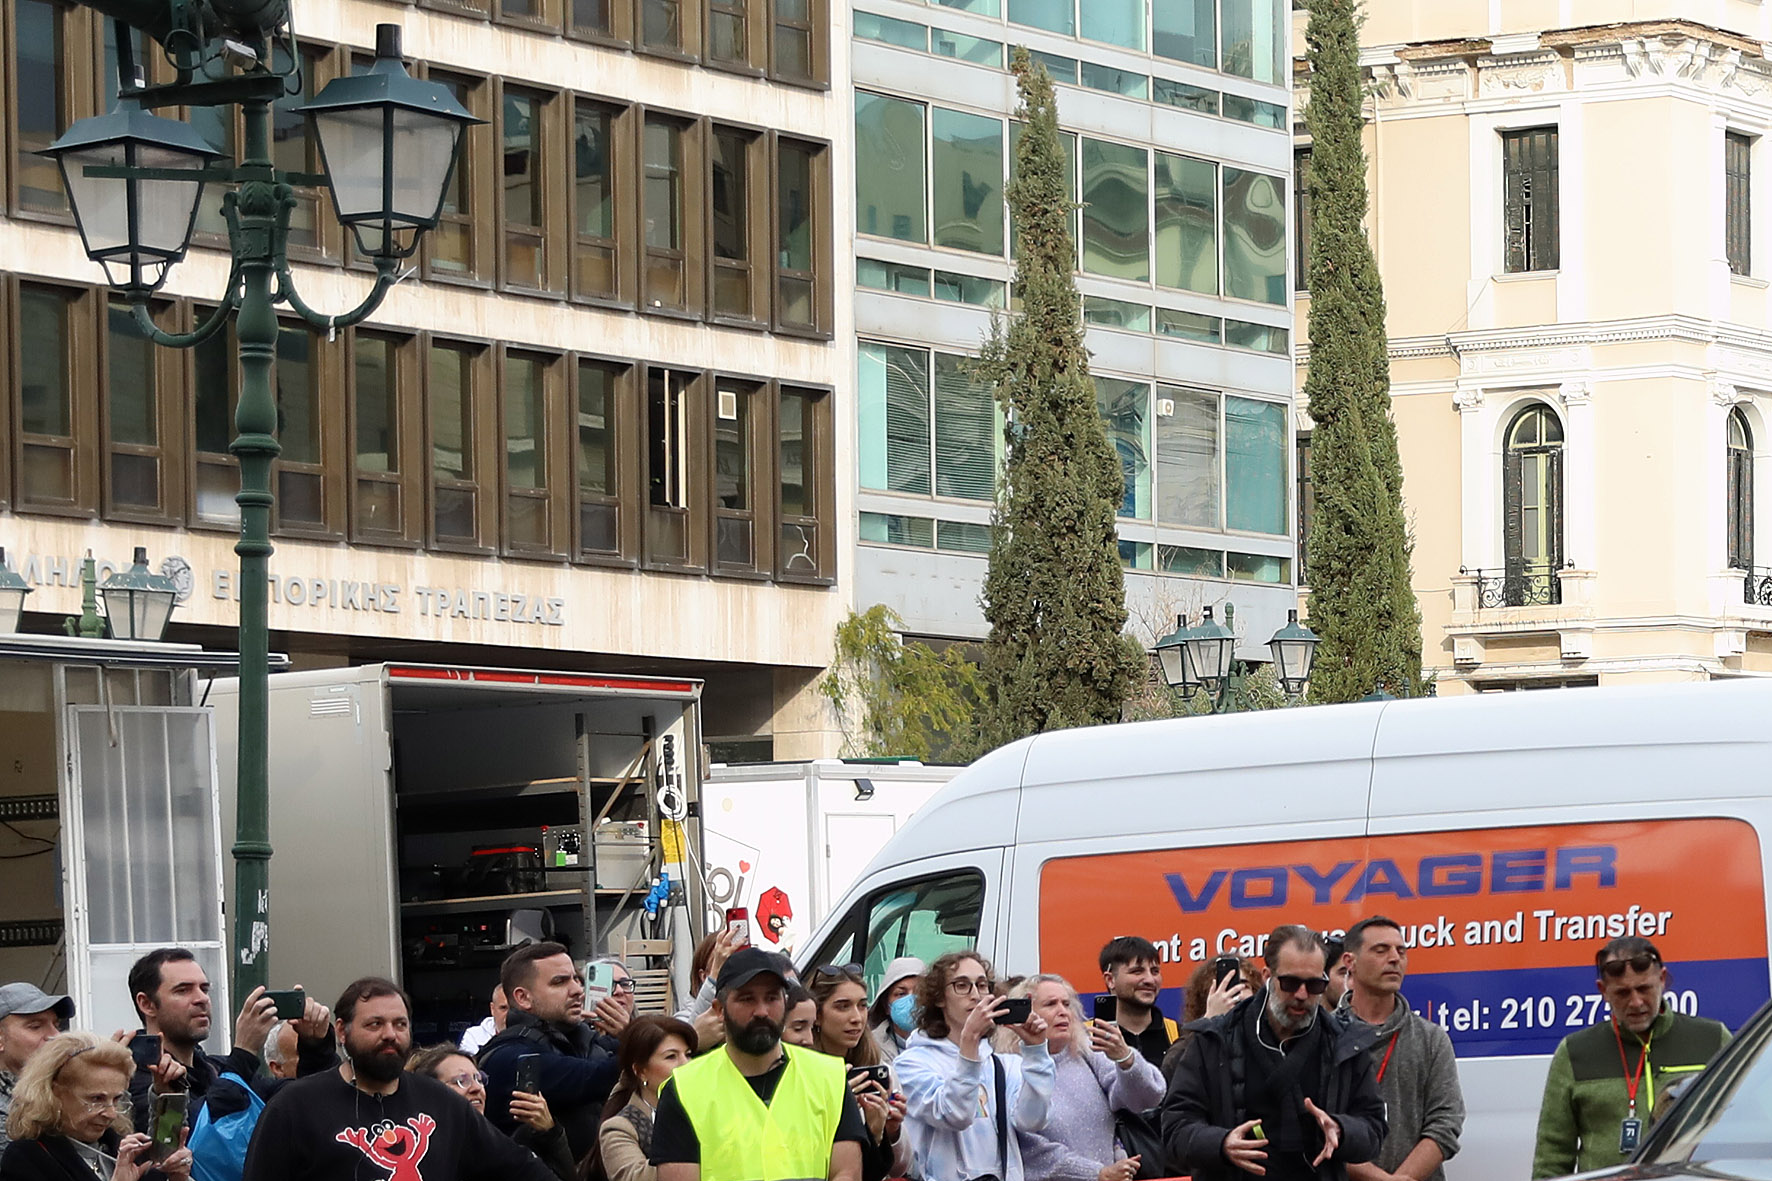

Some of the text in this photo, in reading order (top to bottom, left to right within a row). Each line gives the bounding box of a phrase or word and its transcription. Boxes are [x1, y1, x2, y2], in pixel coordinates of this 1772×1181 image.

[212, 569, 565, 626] ΕΠΟΡΙΚΗΣ ΤΡΑΠΕΖΑΣ
[1162, 845, 1618, 914] VOYAGER
[1188, 937, 1208, 961] a
[1464, 911, 1525, 946] and
[1533, 904, 1673, 942] Transfer
[1437, 999, 1491, 1032] tel:
[1500, 995, 1556, 1030] 210
